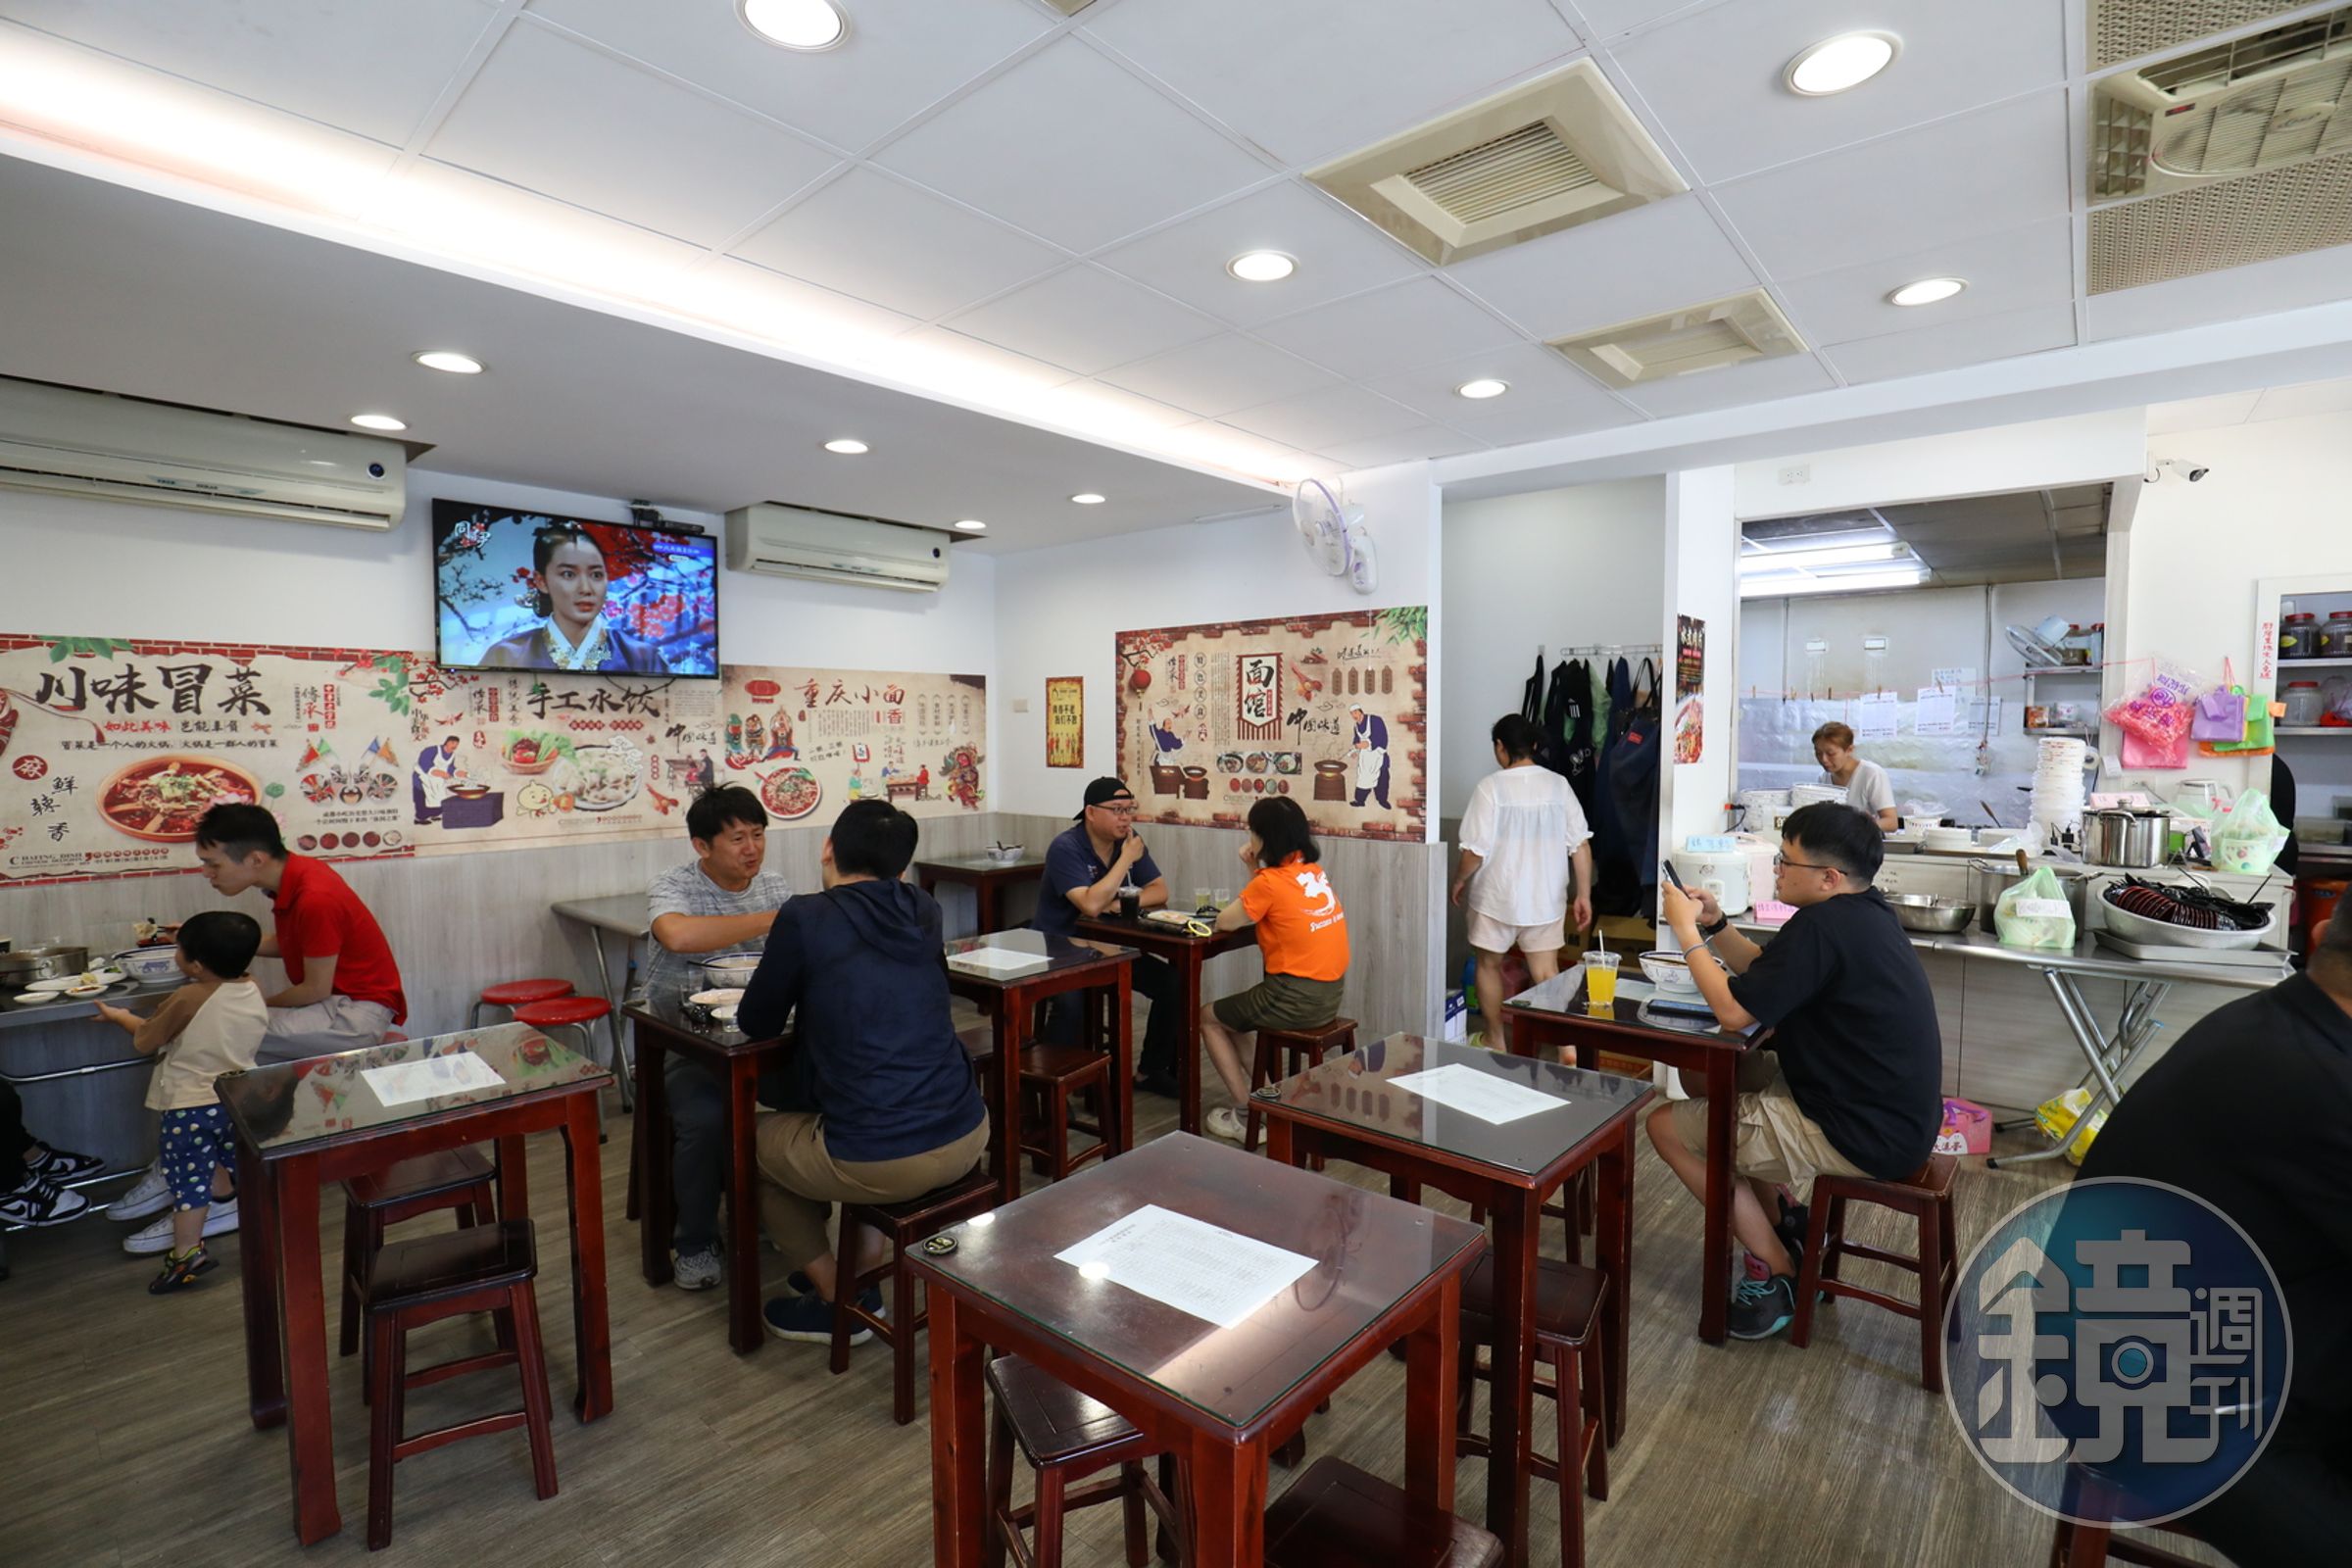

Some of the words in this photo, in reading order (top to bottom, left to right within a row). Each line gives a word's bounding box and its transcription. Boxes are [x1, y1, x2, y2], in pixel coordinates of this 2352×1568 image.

[35, 663, 271, 716] 川味冒菜
[526, 682, 661, 720] 手工水饺
[794, 678, 906, 708] 重庆小面
[104, 720, 172, 733] 如此美味
